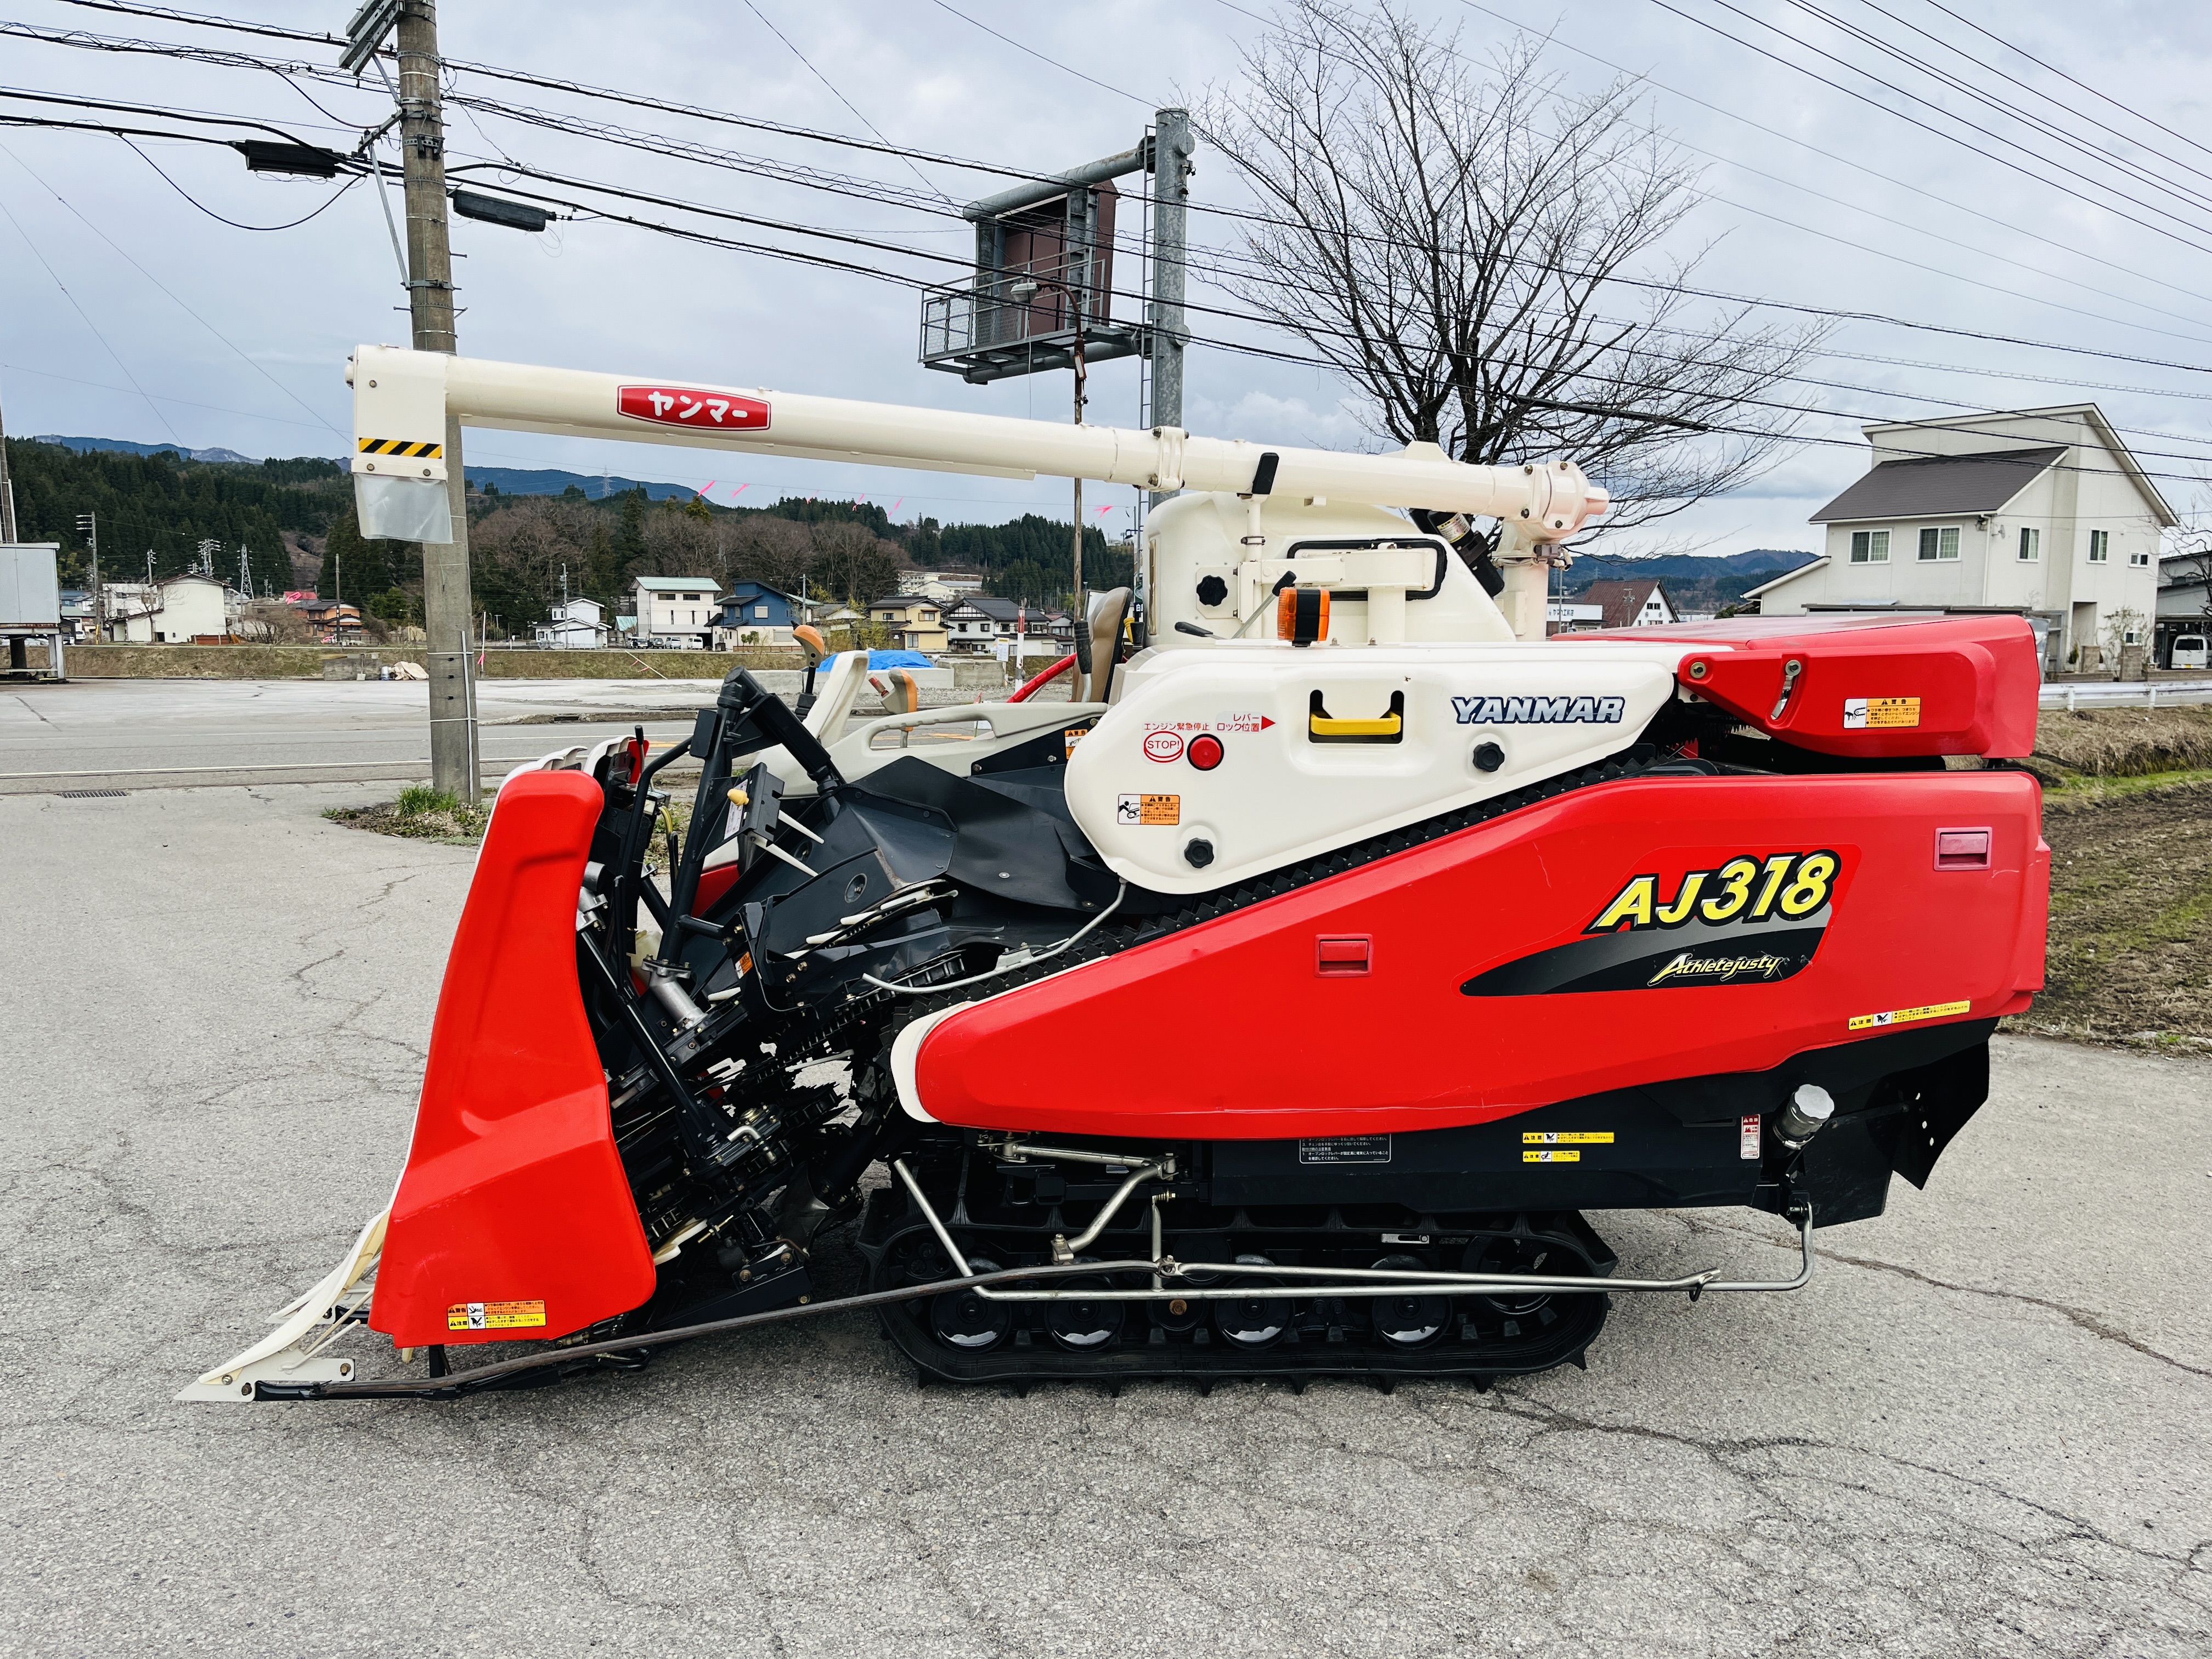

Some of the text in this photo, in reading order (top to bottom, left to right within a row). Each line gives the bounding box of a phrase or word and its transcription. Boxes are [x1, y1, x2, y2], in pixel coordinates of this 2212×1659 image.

[647, 391, 748, 423] ヤンマー
[1233, 713, 1260, 722] レバー
[1450, 696, 1626, 724] YANMAR
[1144, 723, 1210, 731] エンジン緊急停止
[1217, 723, 1260, 732] ロック位置
[1147, 740, 1180, 749] STOP!
[1582, 850, 1841, 934] AJ318
[1647, 953, 1783, 986] Athletejusty
